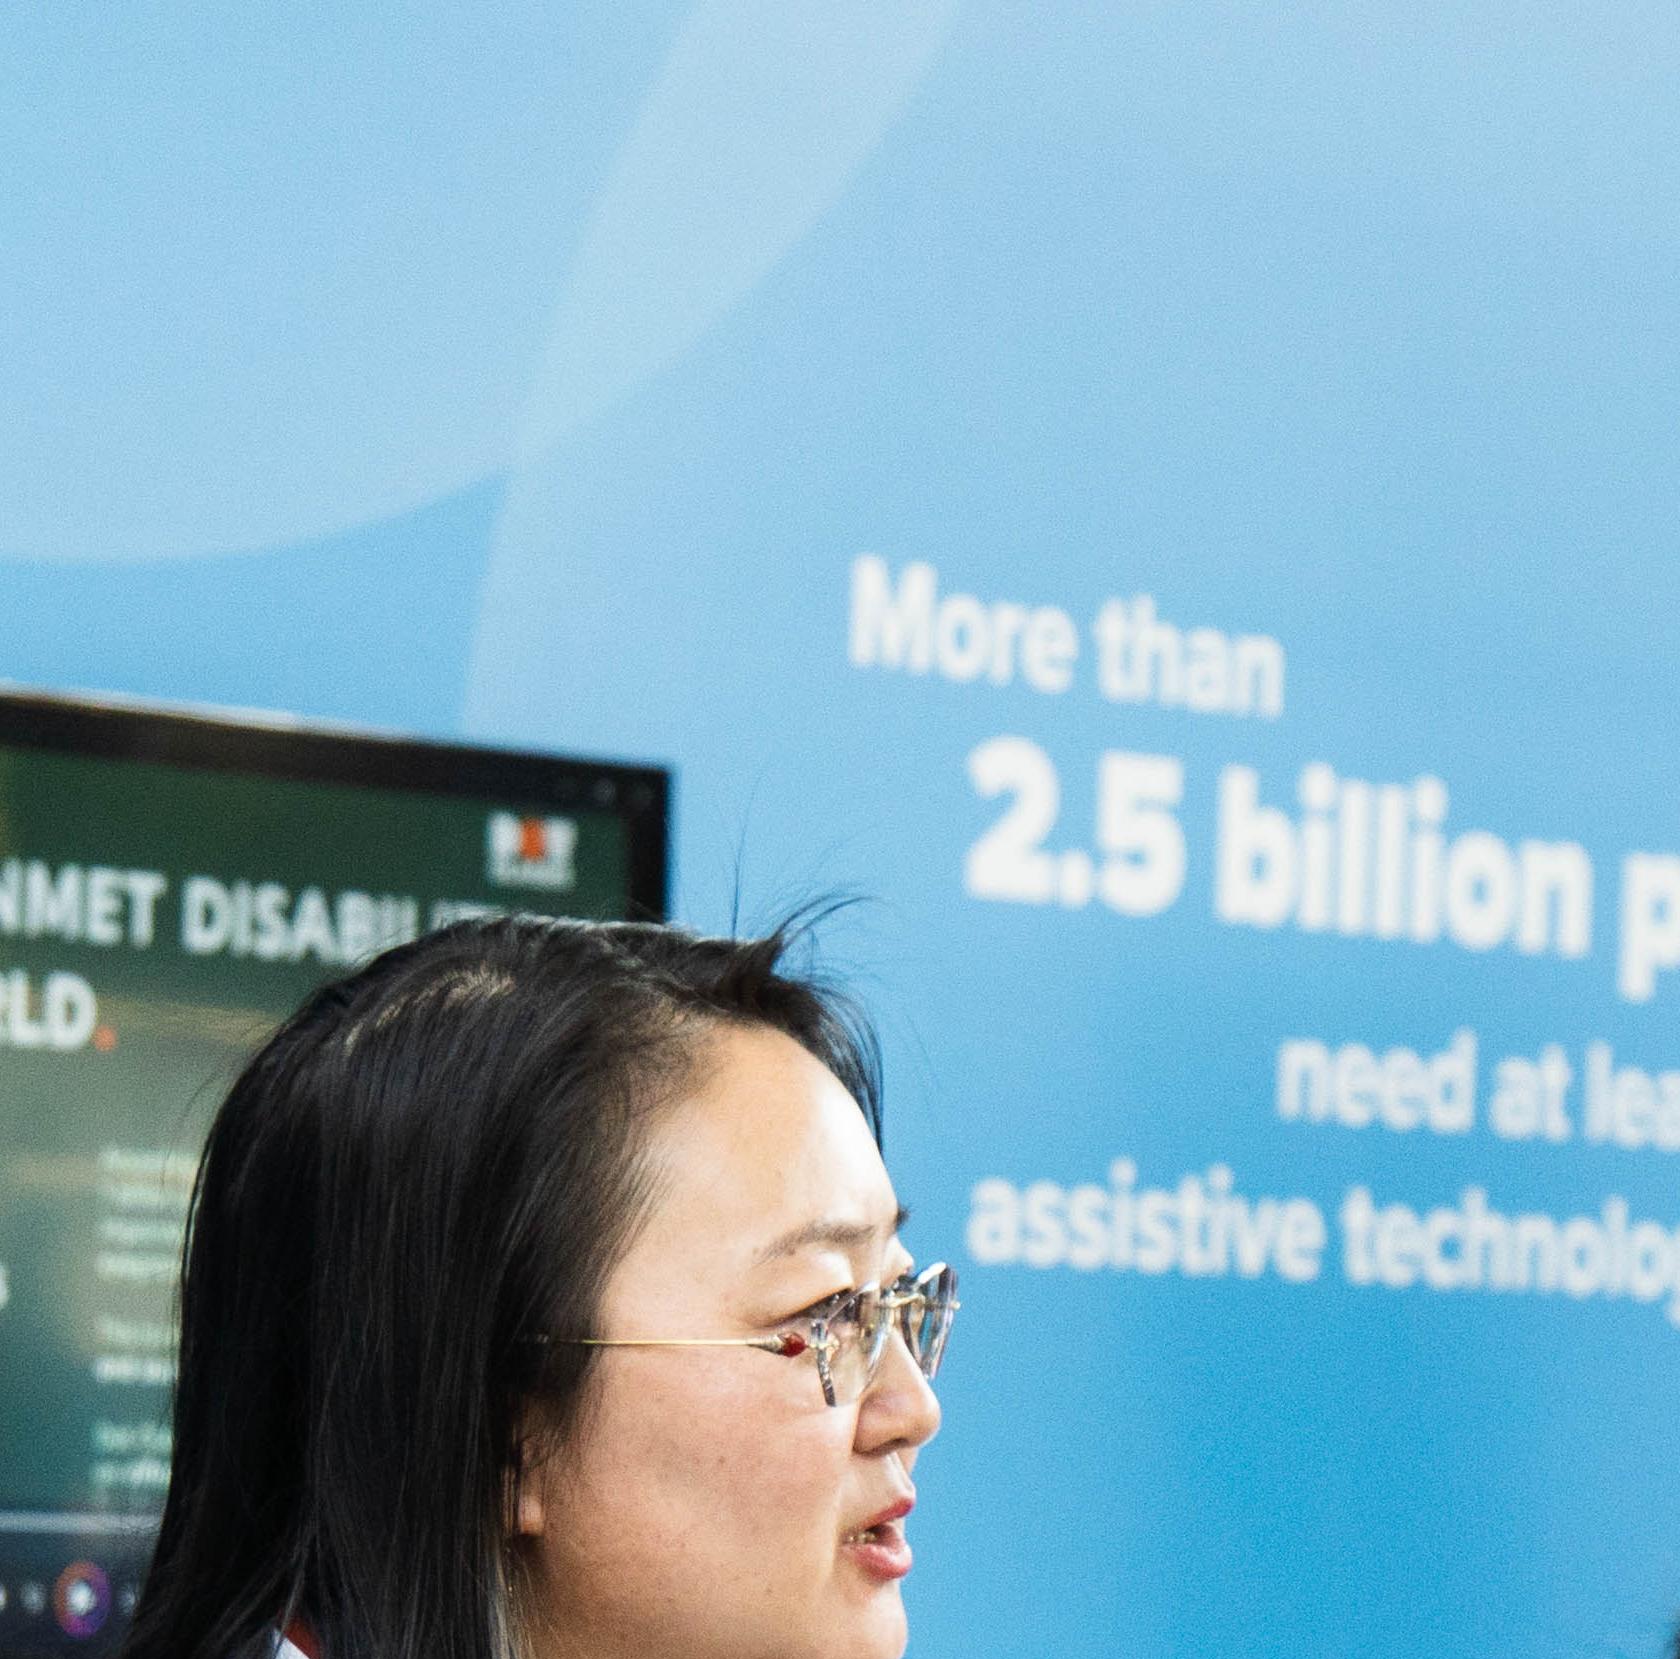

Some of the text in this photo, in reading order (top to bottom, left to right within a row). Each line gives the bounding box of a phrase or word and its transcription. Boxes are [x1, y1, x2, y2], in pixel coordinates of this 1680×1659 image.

[850, 556, 1286, 718] More than
[964, 736, 1188, 914] 2.5
[1213, 763, 1593, 960] billion
[0, 966, 118, 1052] LD.
[1276, 1026, 1475, 1133] need
[1490, 1047, 1574, 1141] at
[966, 1158, 1325, 1283] assistive
